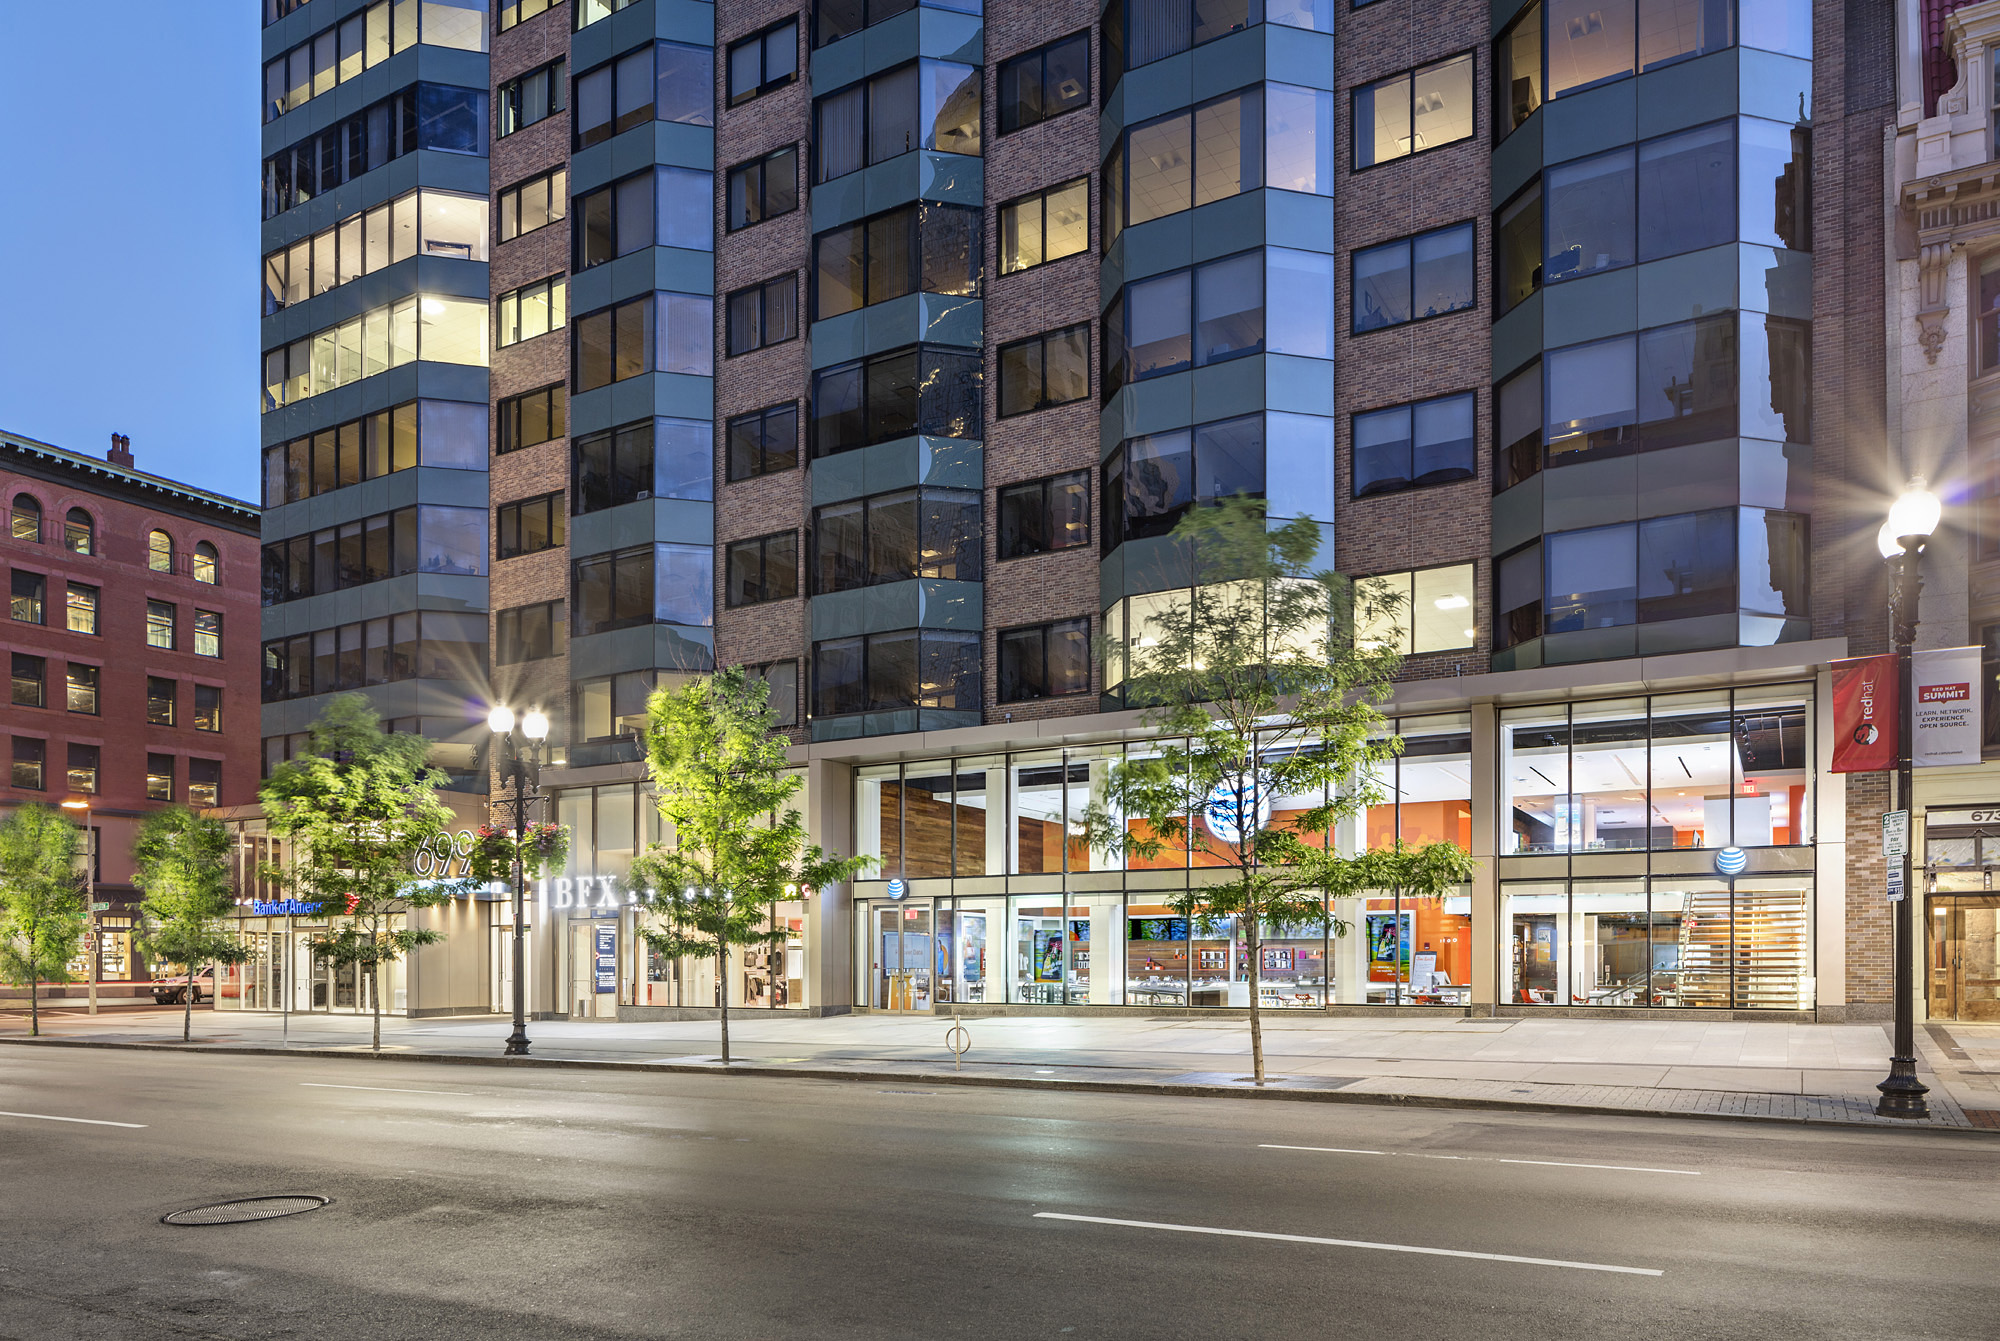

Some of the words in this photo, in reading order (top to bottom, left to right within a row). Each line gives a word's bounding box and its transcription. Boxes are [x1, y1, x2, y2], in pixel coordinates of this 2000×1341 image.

[1861, 680, 1874, 720] redhat
[1923, 690, 1966, 700] SUMMIT
[1883, 815, 1890, 825] 2
[413, 830, 475, 877] 699
[554, 875, 619, 909] BFX
[253, 899, 278, 915] Bank
[278, 898, 289, 915] of
[289, 898, 324, 915] Ameri
